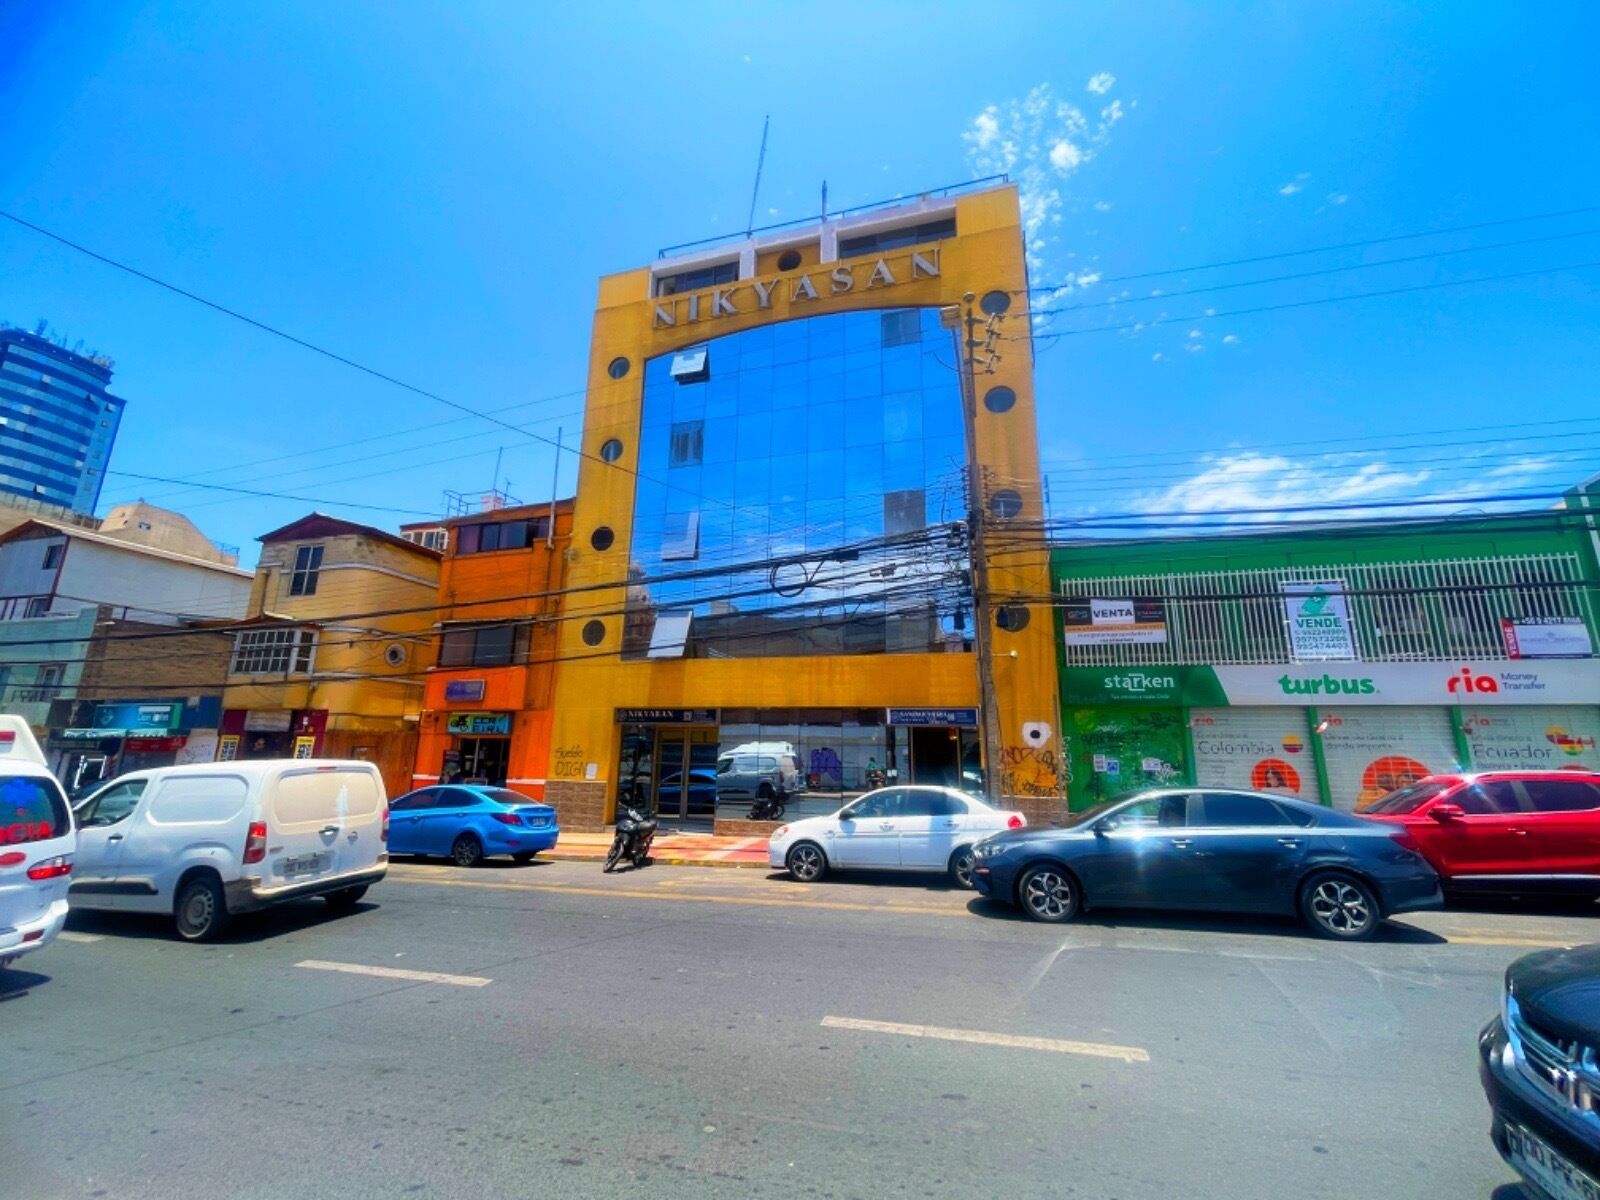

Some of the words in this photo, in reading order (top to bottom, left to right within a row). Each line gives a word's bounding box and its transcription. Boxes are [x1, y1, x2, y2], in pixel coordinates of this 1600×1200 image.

[653, 248, 941, 328] NIKYASAN
[1093, 609, 1134, 618] VENTA
[1295, 616, 1342, 628] VENDE
[1104, 673, 1174, 691] starken
[1278, 674, 1375, 694] turbus
[1447, 668, 1498, 693] ria
[1501, 672, 1538, 682] Money
[1501, 681, 1546, 690] Transfer
[1198, 740, 1274, 755] Colombia
[1473, 743, 1552, 759] Ecuador
